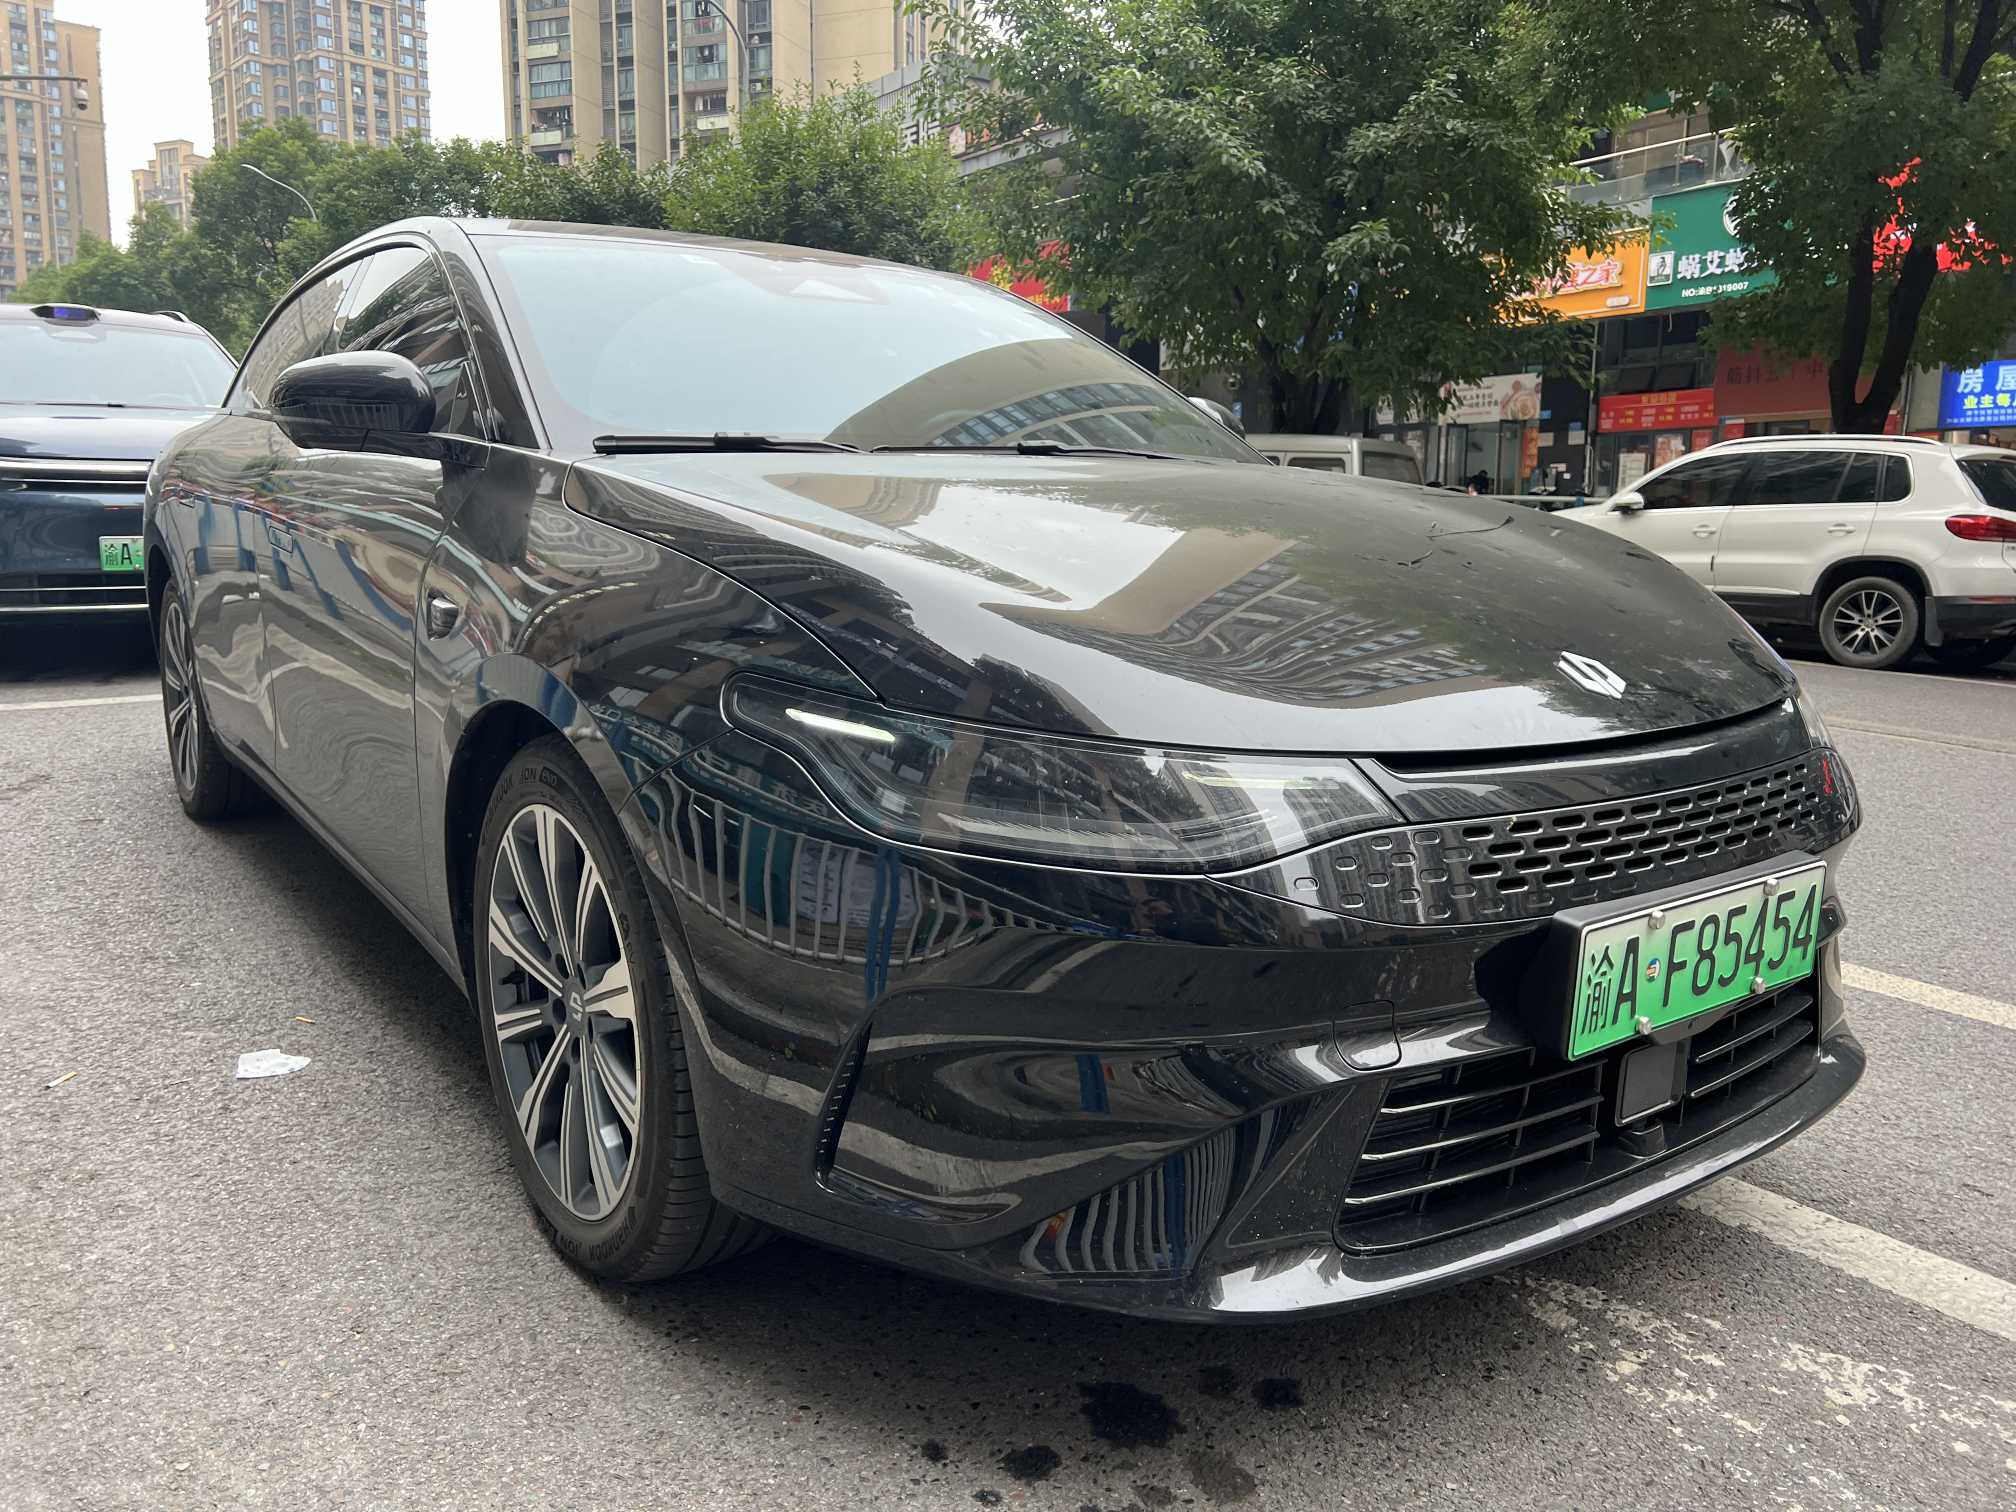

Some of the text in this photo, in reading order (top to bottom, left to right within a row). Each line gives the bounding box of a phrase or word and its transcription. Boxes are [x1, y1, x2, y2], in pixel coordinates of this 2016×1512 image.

[104, 543, 133, 566] 渝A
[1581, 884, 1817, 1035] 渝A F85454
